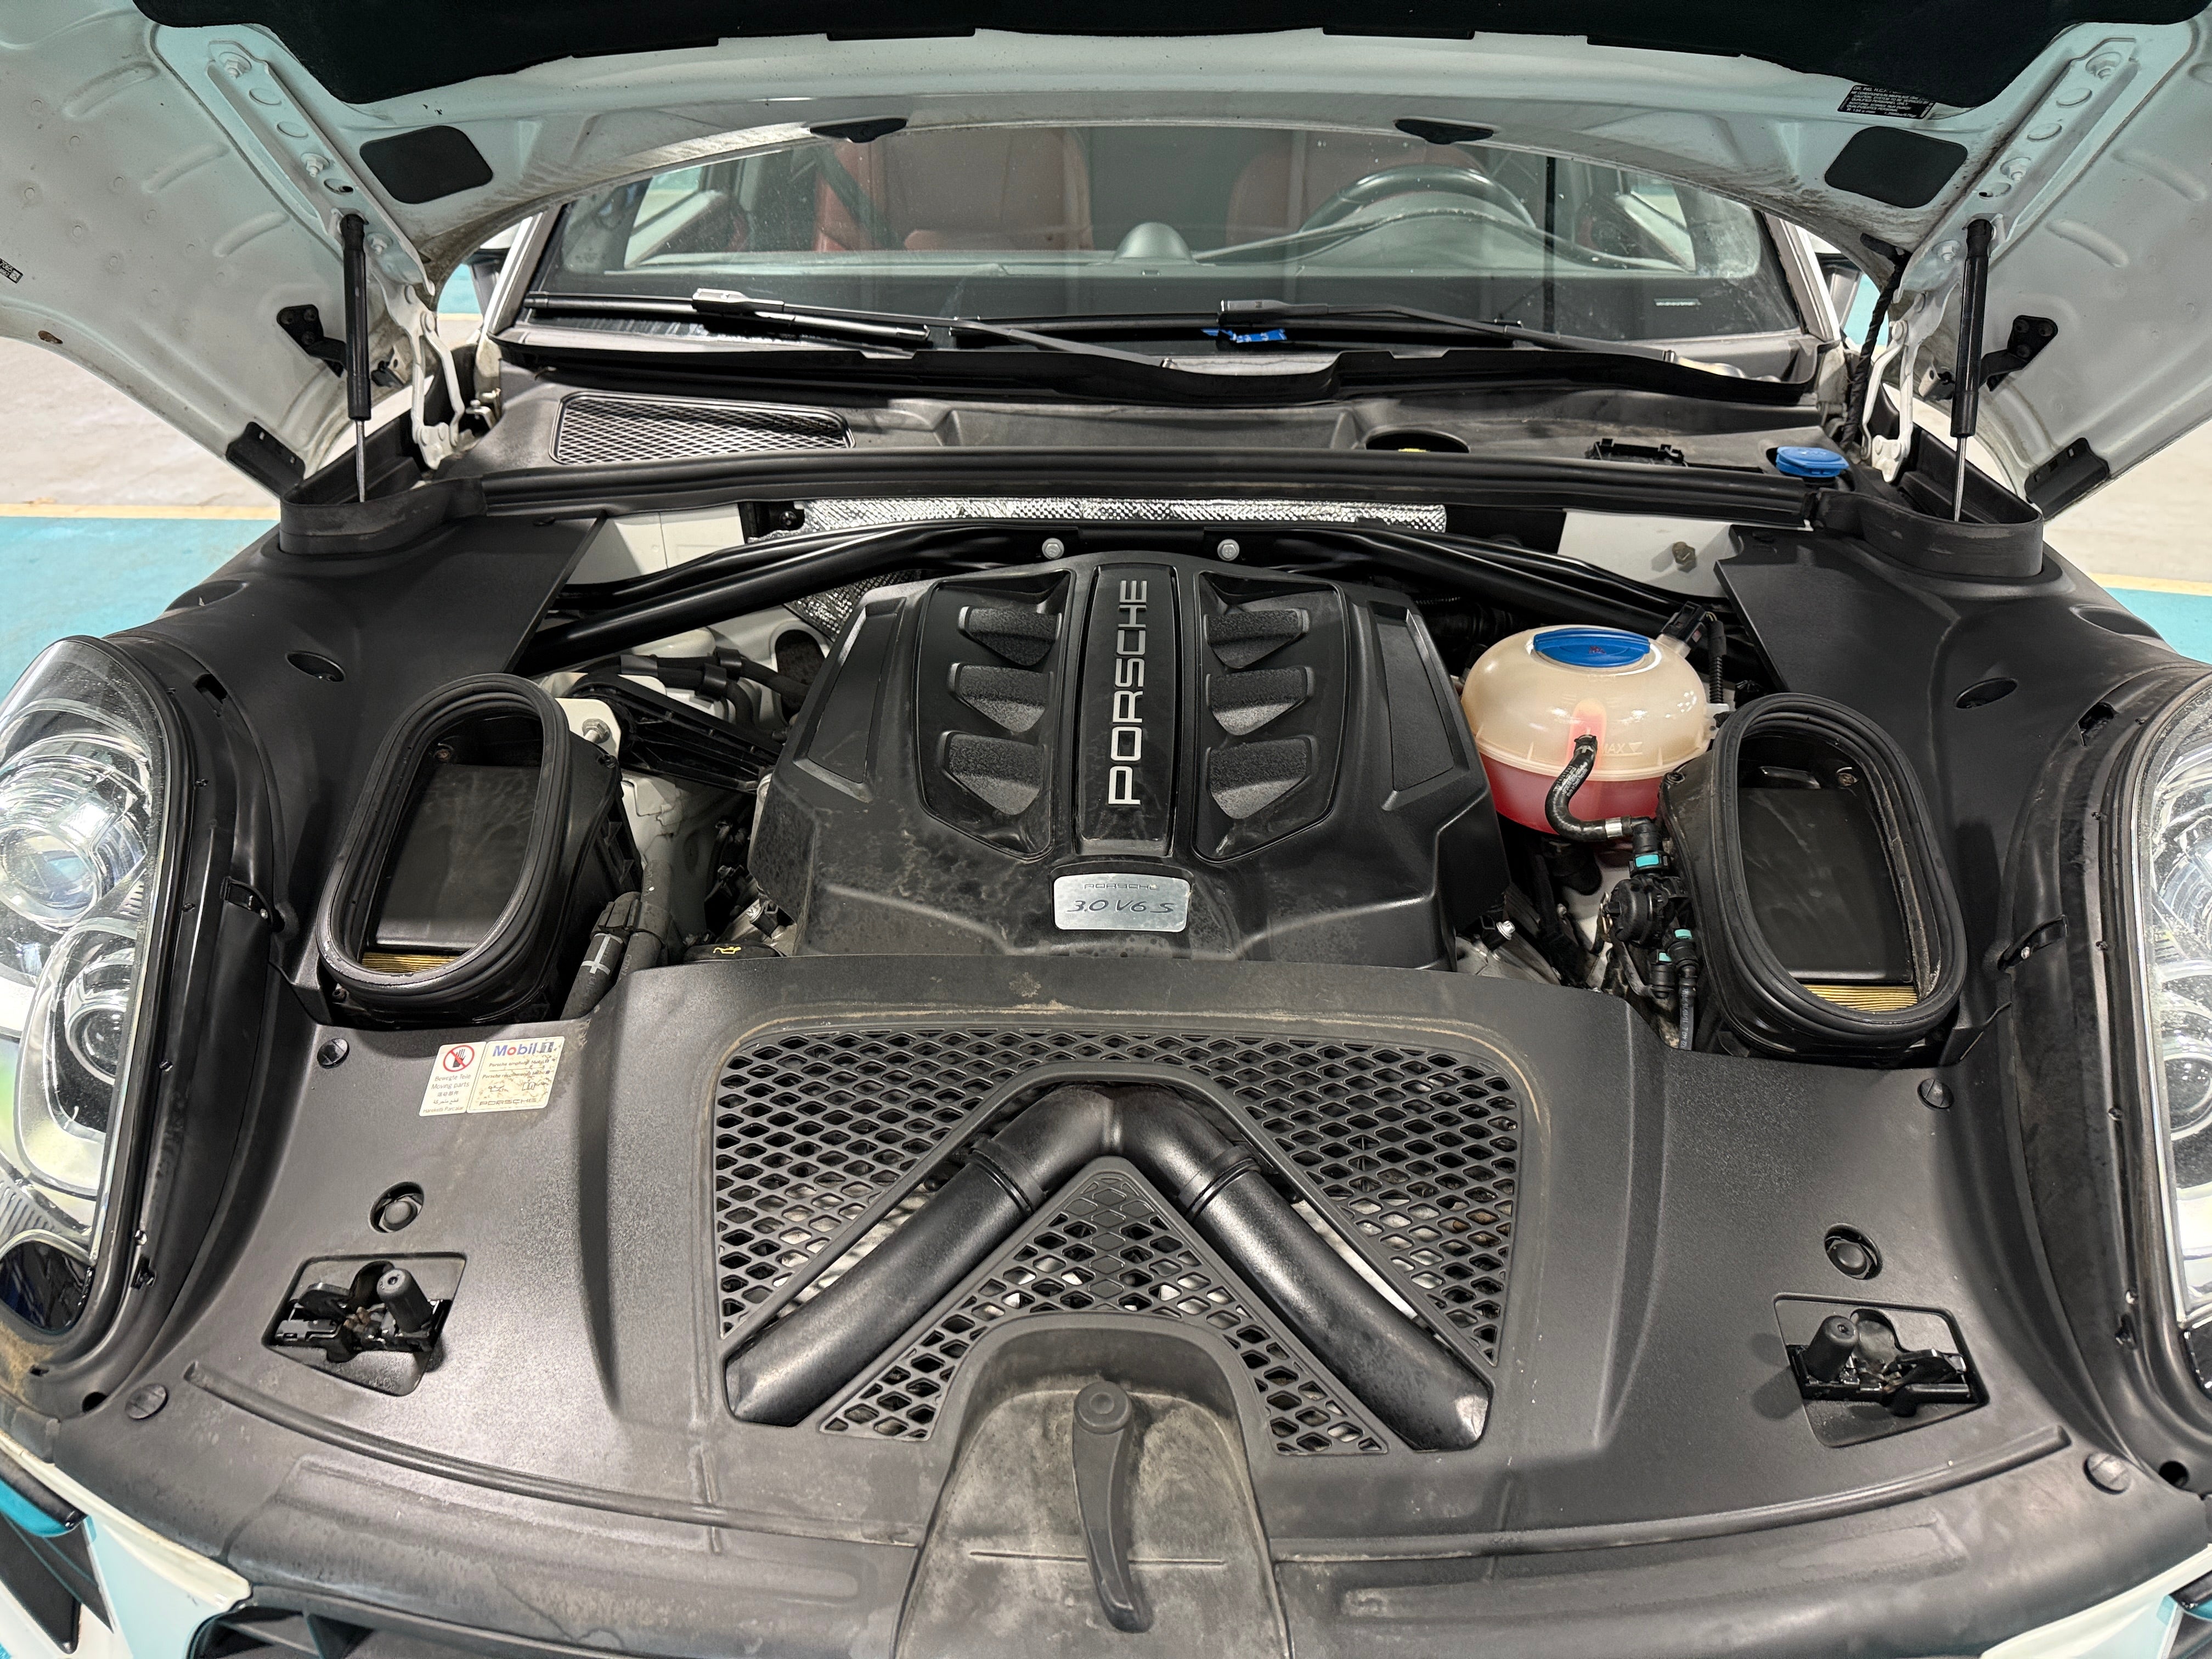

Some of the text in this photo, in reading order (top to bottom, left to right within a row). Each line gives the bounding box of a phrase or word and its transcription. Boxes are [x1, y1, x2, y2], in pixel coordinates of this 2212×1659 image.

[1107, 579, 1147, 805] PORSCHE
[1083, 883, 1160, 891] PORSCHE
[1066, 899, 1175, 913] 3.0 V6 S
[492, 1042, 538, 1057] Mobil
